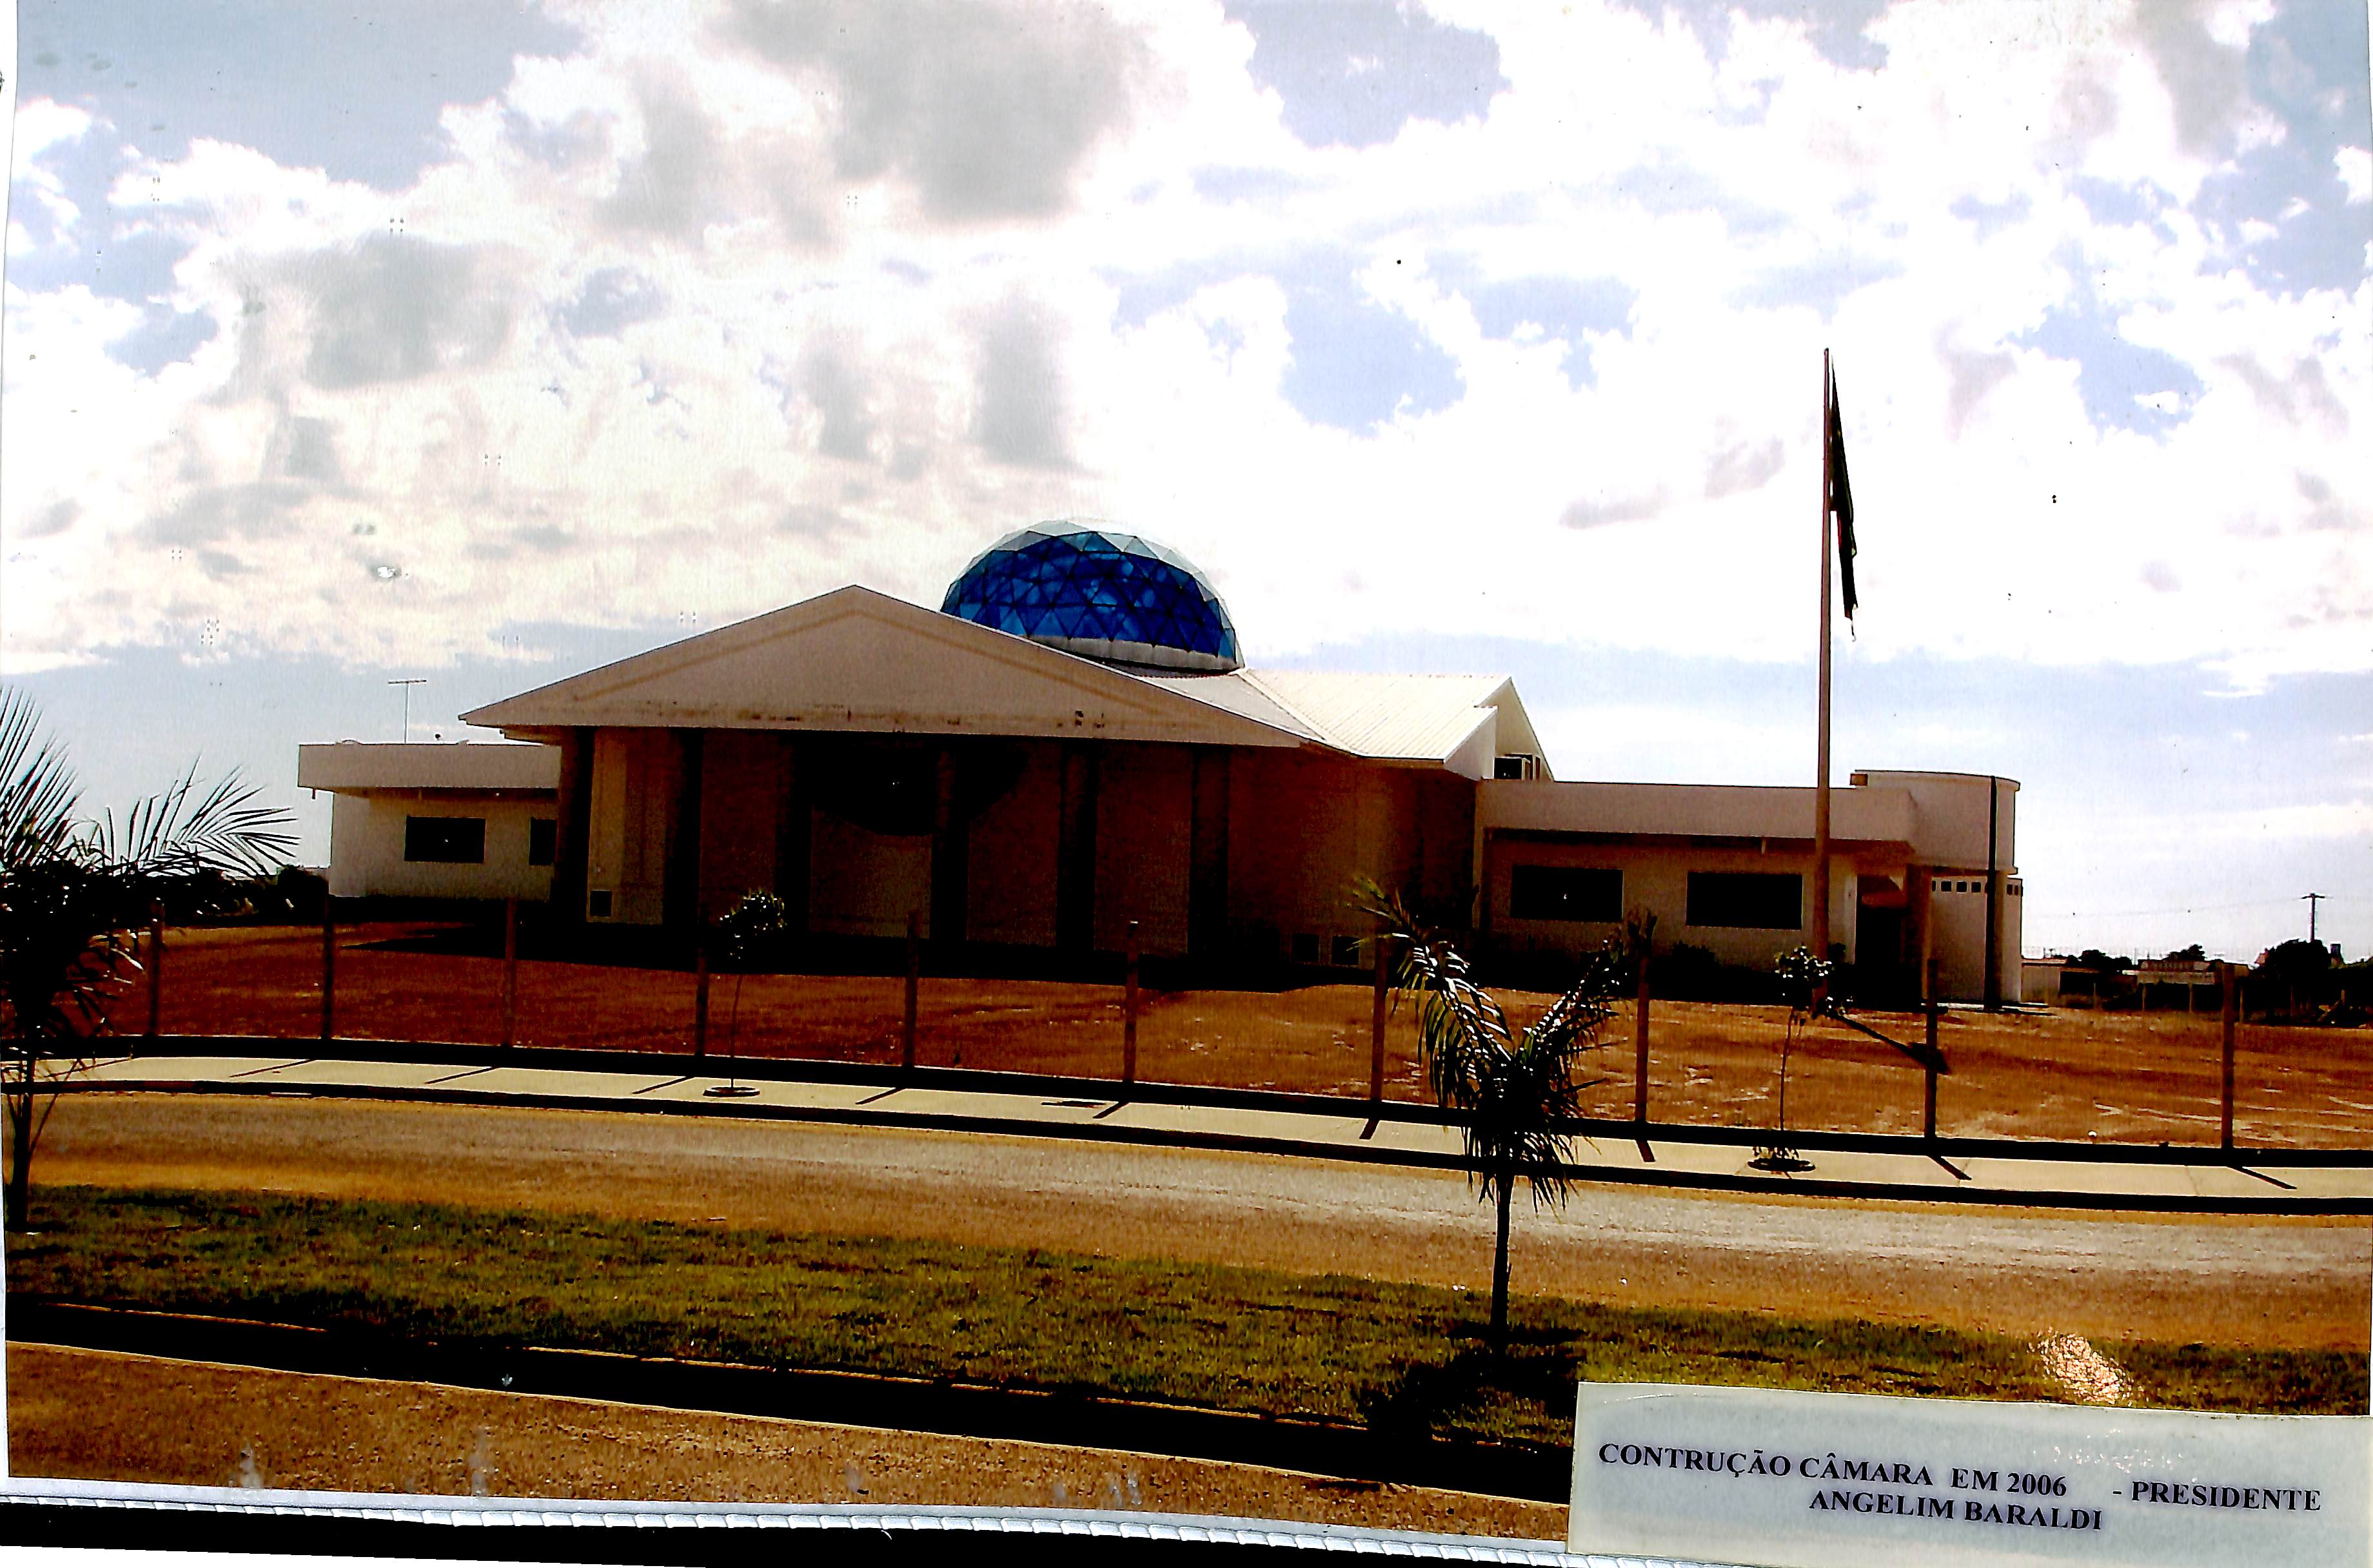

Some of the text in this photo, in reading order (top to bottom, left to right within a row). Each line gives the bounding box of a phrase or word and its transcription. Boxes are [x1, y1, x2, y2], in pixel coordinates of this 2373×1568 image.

[1598, 1443, 1791, 1478] CONTRUÇÃO
[1799, 1452, 1933, 1486] CÂMARA
[1950, 1467, 1999, 1492] EM
[2006, 1473, 2067, 1496] 2006
[2131, 1481, 2321, 1511] PRESIDENTE
[1809, 1490, 2102, 1530] ANGELIM BARALDI
